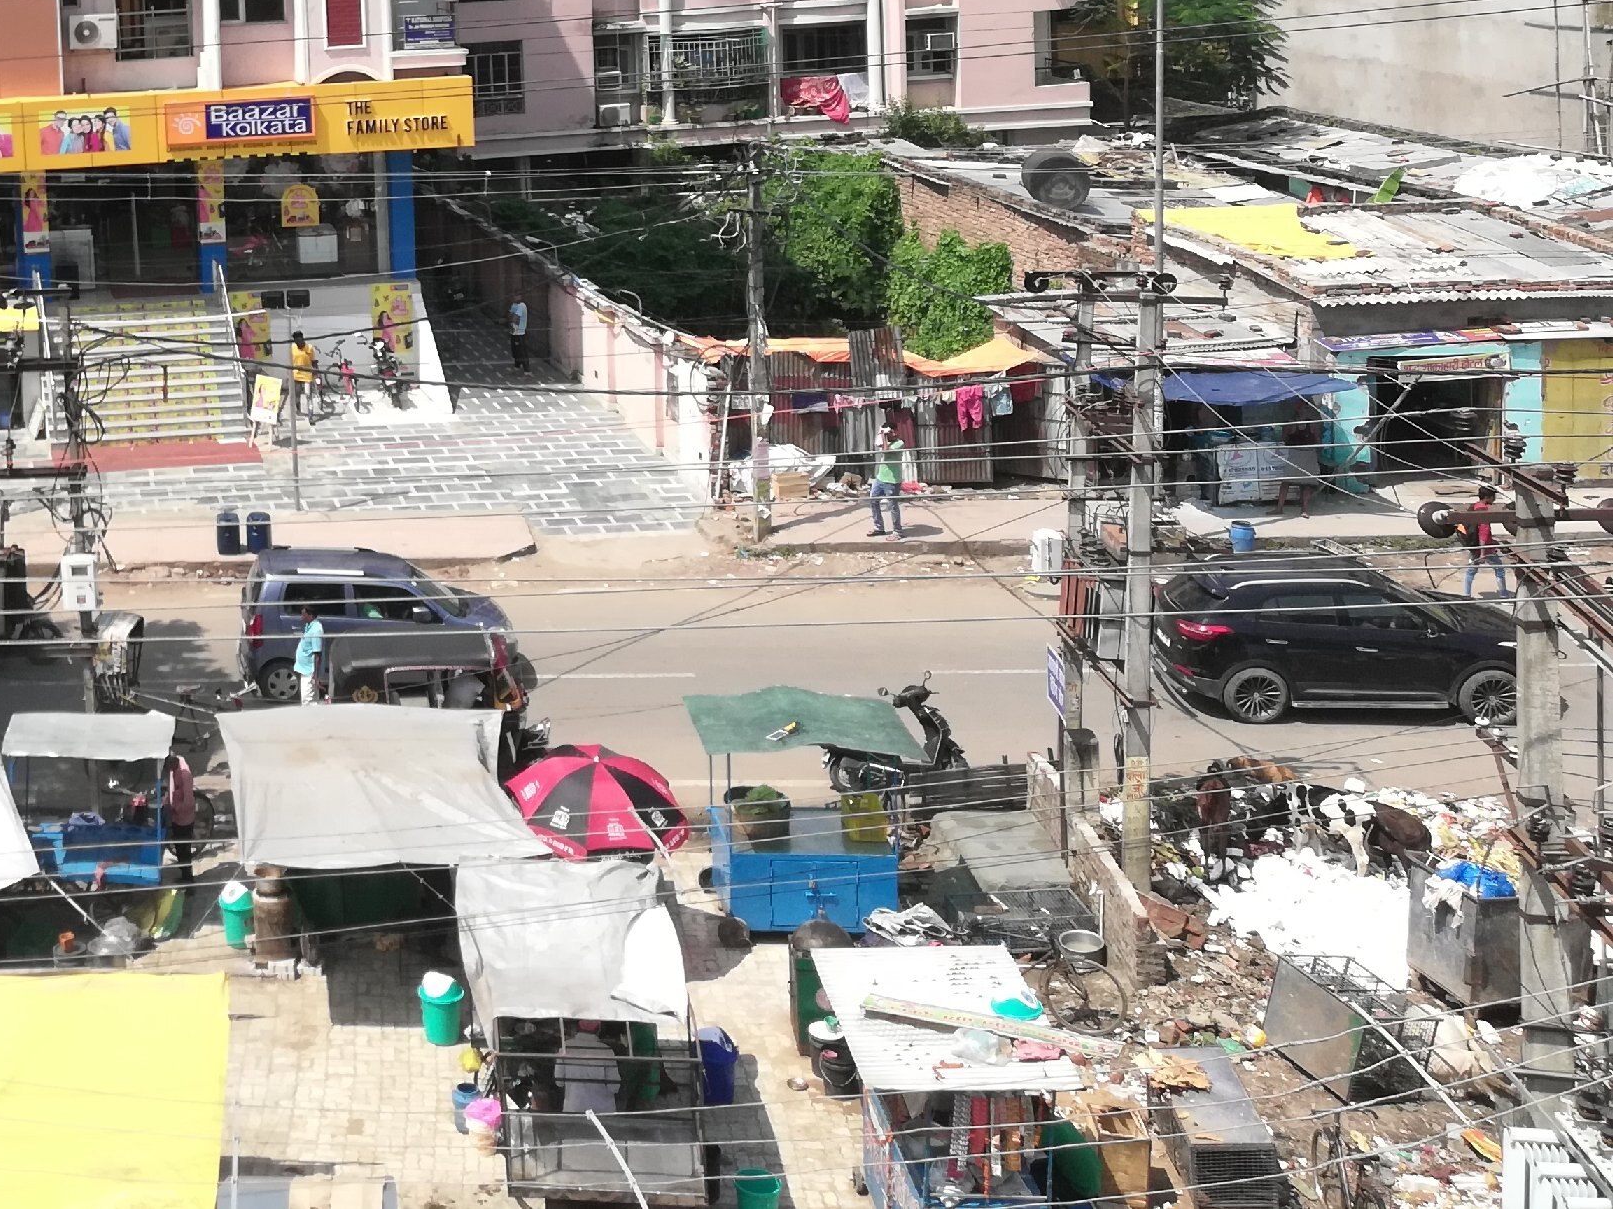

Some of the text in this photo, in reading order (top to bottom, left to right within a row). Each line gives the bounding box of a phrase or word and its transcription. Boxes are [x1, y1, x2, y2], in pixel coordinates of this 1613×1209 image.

[209, 104, 305, 125] Baazar
[348, 101, 371, 115] THE
[220, 119, 307, 137] Kolkata
[347, 115, 448, 135] FAMILY STORE
